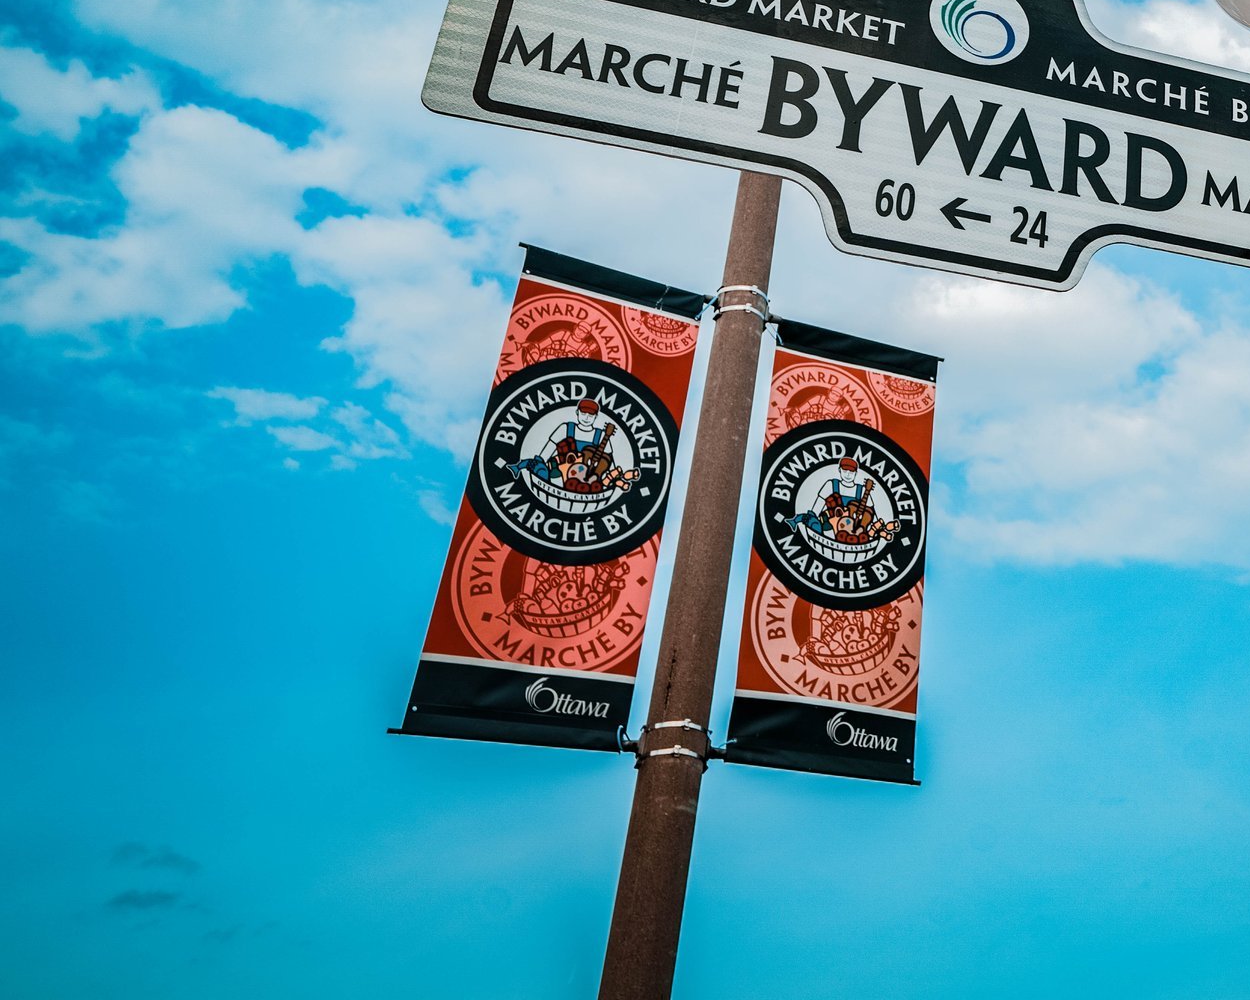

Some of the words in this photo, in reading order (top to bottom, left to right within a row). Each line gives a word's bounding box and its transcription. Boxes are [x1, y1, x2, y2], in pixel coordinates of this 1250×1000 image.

[1046, 57, 1210, 116] MARCHÉ
[498, 25, 744, 109] MARCHÉ
[758, 55, 1187, 212] BYWARD
[875, 179, 915, 221] 60
[1009, 206, 1049, 248] 24
[515, 303, 589, 330] BYWARD
[590, 319, 621, 367] MARK
[681, 334, 694, 347] BY
[495, 381, 587, 446] BYWARD
[594, 387, 660, 474] MARKET
[776, 371, 839, 397] BYWARD
[841, 384, 872, 427] MARK
[922, 394, 933, 406] BY
[494, 481, 598, 542] MARCHÉ
[602, 504, 633, 534] BY
[772, 441, 846, 502] BYWARD
[852, 445, 917, 525] MARKET
[470, 538, 502, 597] BYW
[777, 536, 870, 589] MARCHÉ
[872, 553, 898, 581] BY
[493, 629, 616, 668] MARCHÉ
[612, 602, 644, 637] BY
[766, 587, 790, 641] BYW
[525, 677, 610, 718] Ottawa
[794, 668, 898, 703] MARCHÉ
[892, 644, 917, 676] BY
[826, 711, 898, 752] Ottawa
